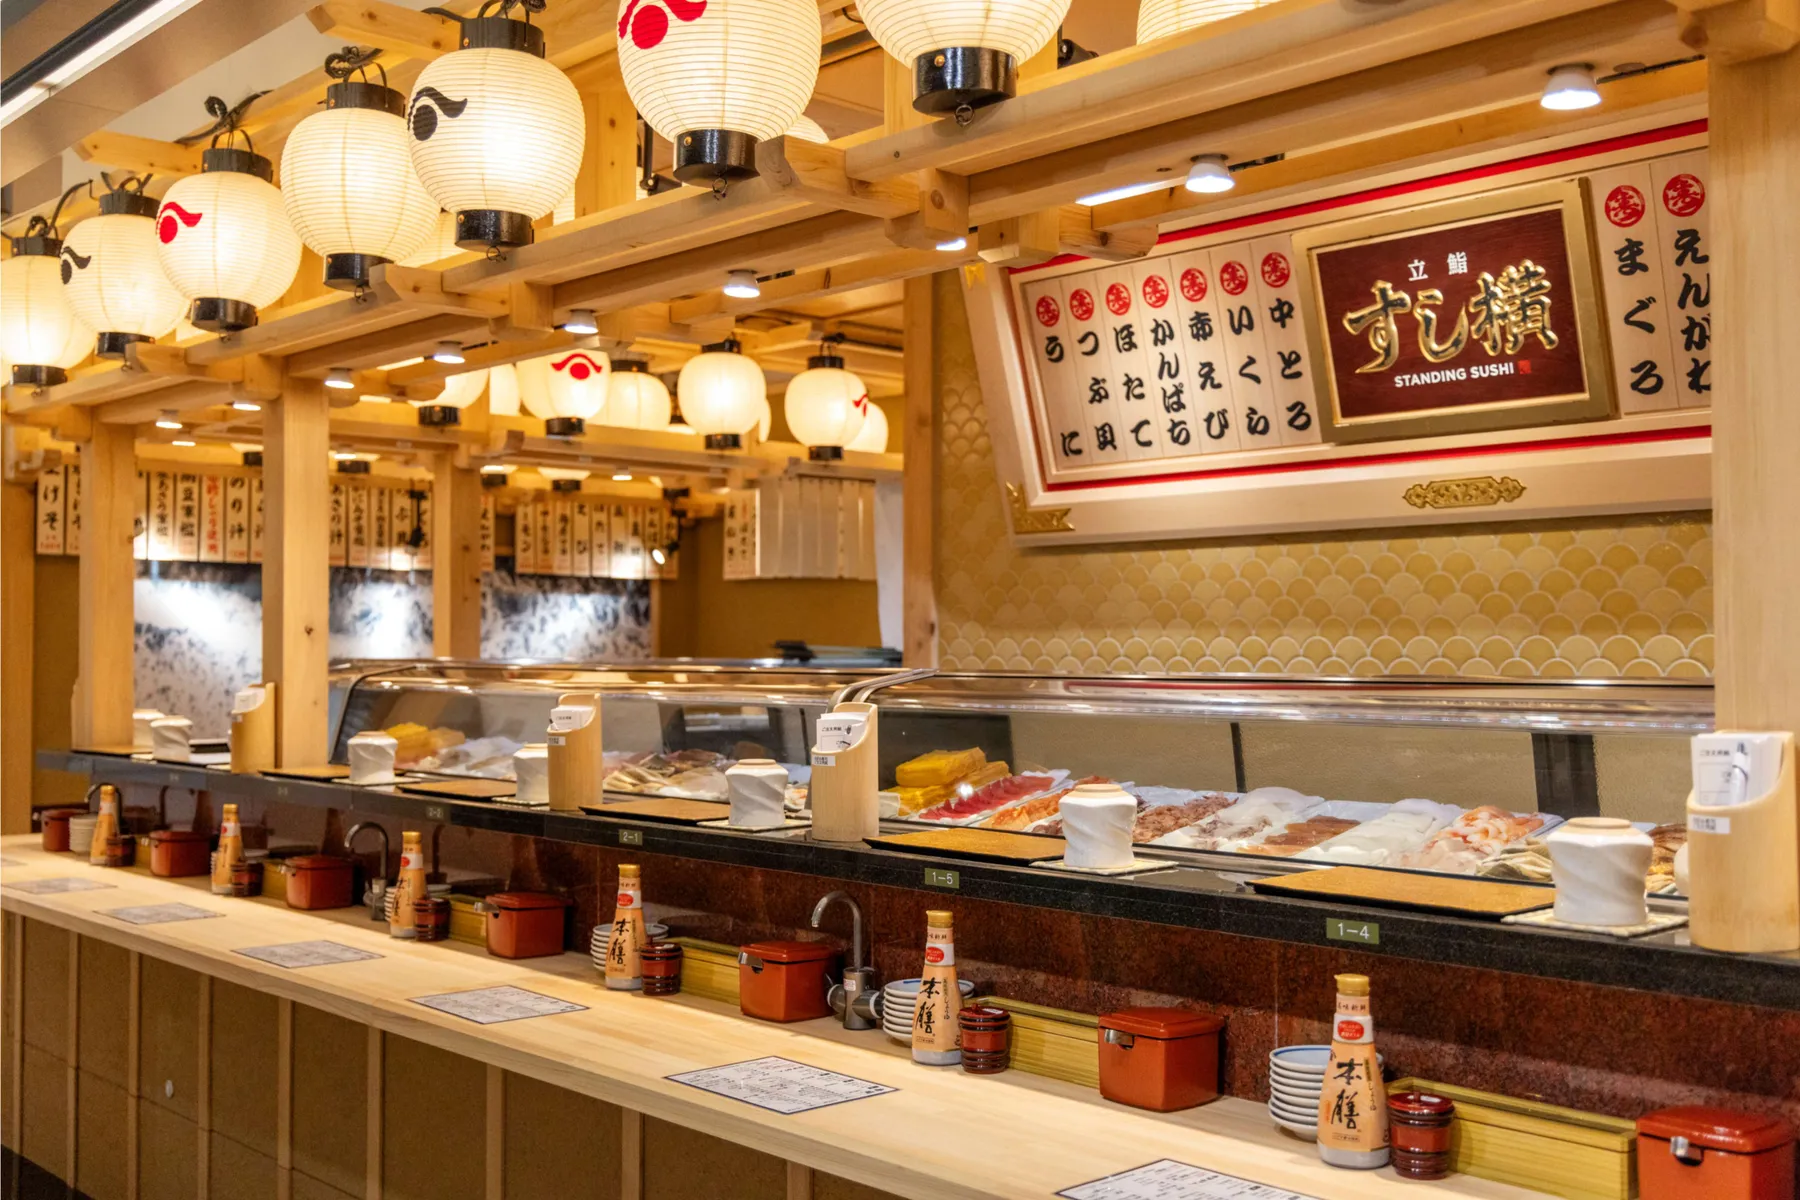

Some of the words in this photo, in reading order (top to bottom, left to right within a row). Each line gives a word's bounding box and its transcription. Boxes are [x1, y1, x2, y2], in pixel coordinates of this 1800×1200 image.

[1228, 305, 1269, 436] いくら
[1269, 298, 1312, 431] 中とろ
[1342, 259, 1559, 374] すし横
[1394, 367, 1467, 388] STANDING
[1470, 362, 1514, 378] SUSHI
[1614, 238, 1663, 395] まぐろ
[1045, 336, 1083, 456] うに
[1077, 331, 1117, 450] つぶ貝
[1113, 324, 1153, 448] ほたて
[1150, 318, 1191, 446] かんぱち
[1189, 311, 1229, 440] 赤えび
[43, 468, 60, 531] げそ
[623, 831, 639, 843] 2-1
[932, 871, 953, 885] 1-5
[1338, 922, 1369, 940] 1-4
[915, 977, 942, 1034] 本膳
[1331, 1058, 1363, 1129] 本膳
